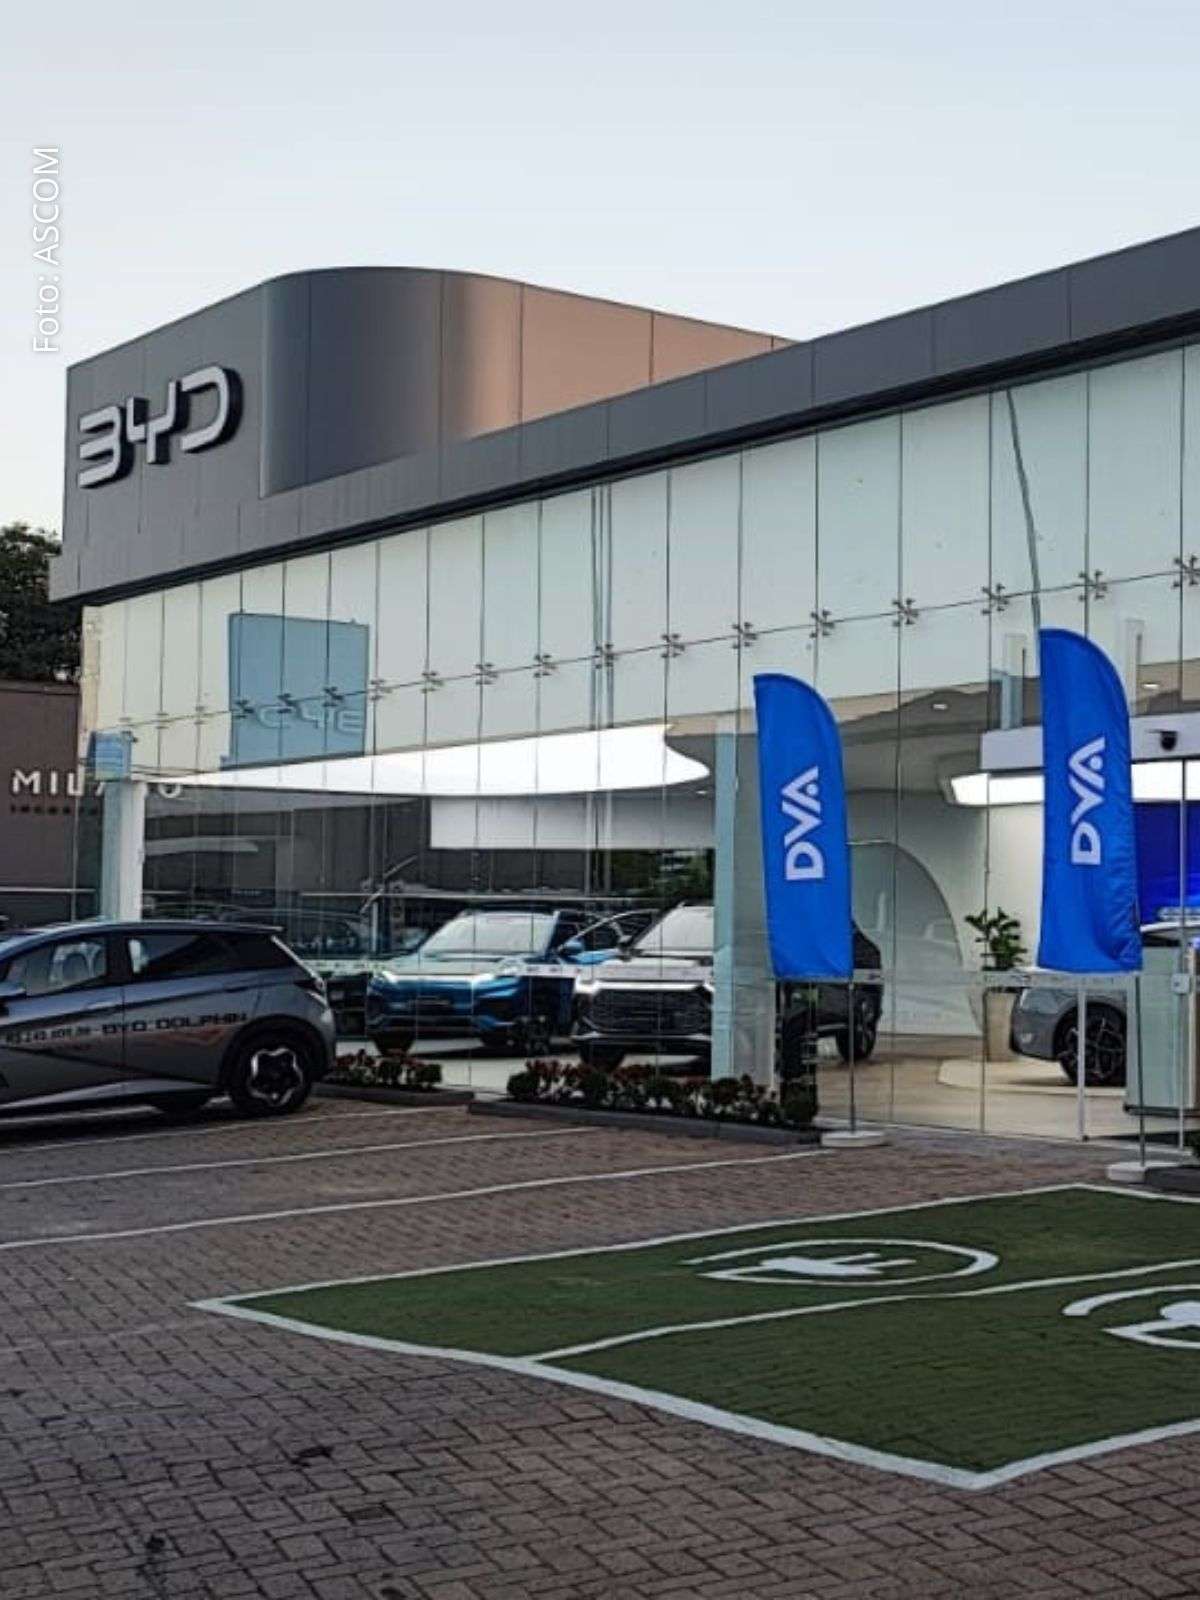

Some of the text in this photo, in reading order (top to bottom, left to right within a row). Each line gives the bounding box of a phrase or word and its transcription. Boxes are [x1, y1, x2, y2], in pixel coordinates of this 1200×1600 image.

[78, 365, 243, 489] BYD
[781, 767, 825, 881] DVA
[1068, 737, 1107, 866] DVA
[156, 1013, 247, 1029] DOLPHIN
